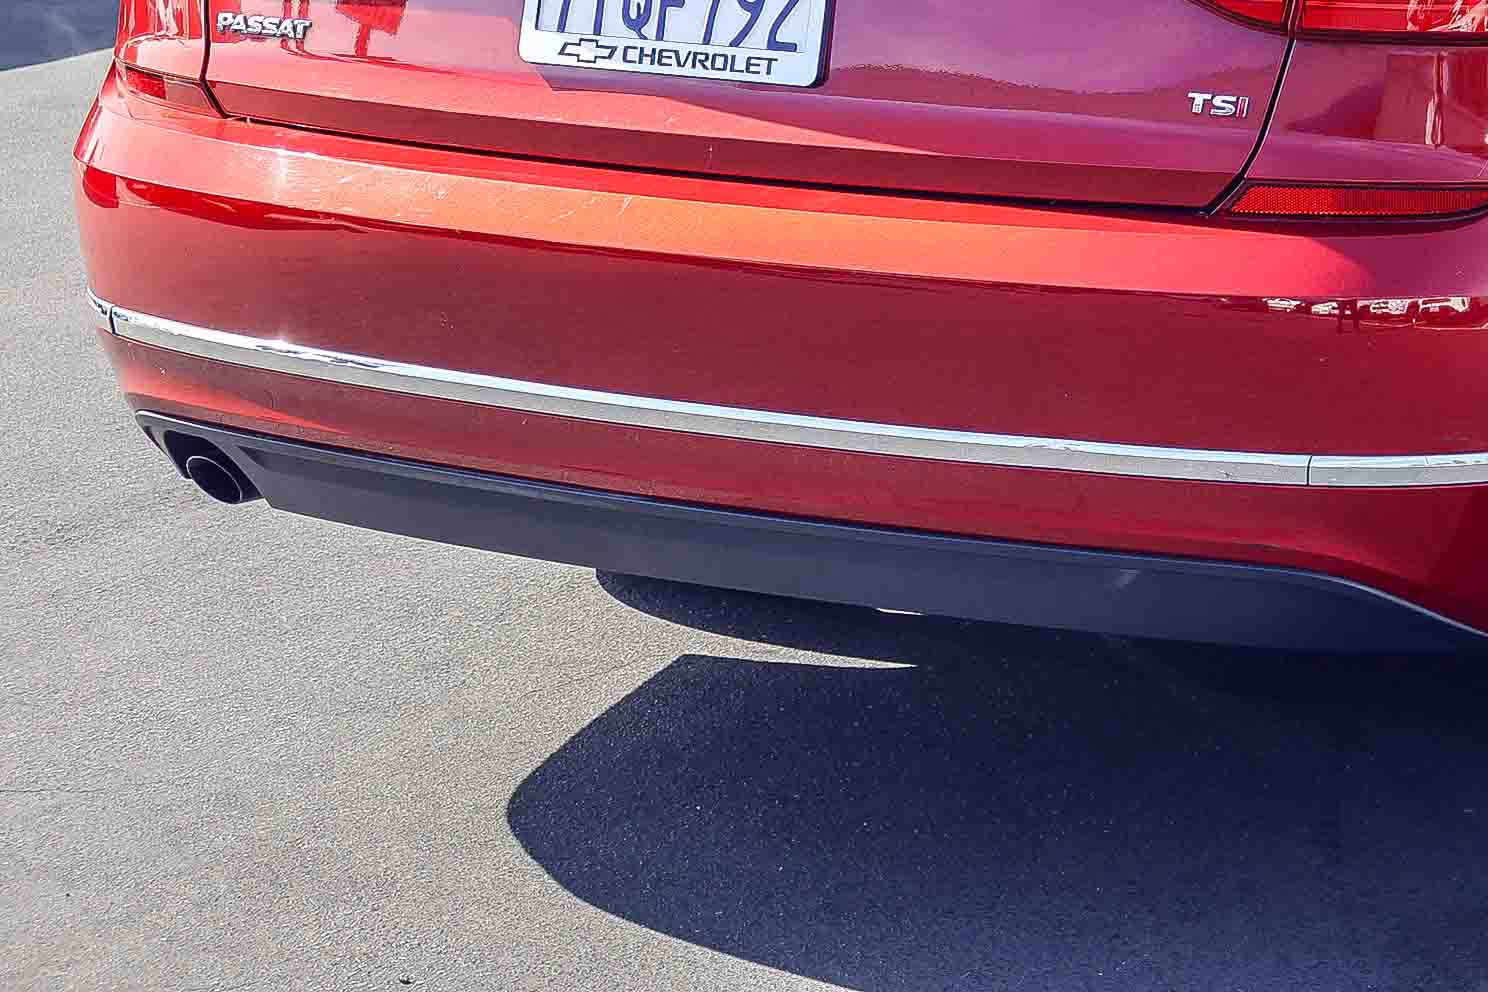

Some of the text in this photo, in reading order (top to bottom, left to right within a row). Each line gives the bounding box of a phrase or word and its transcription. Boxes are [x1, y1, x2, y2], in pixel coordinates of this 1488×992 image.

[216, 12, 312, 40] PASSAT
[621, 45, 779, 76] CHEVROLET
[1187, 91, 1250, 118] TSI
